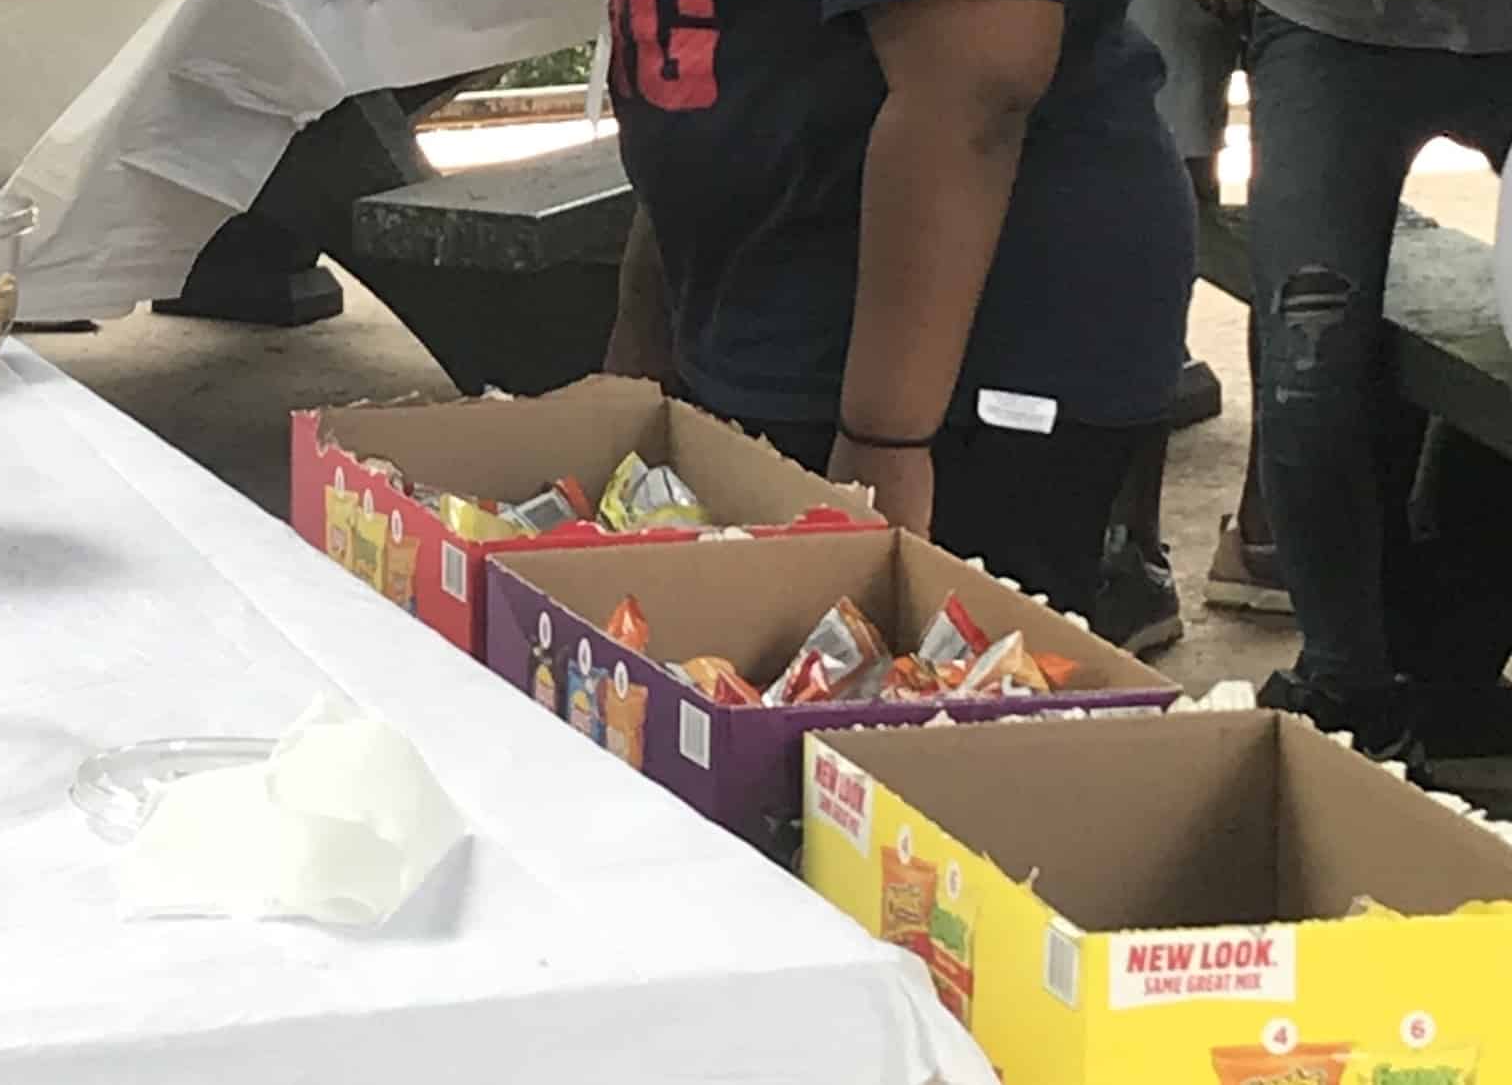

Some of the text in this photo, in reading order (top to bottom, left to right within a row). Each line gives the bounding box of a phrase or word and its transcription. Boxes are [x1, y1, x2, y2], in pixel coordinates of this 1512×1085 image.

[1125, 942, 1194, 973] NEW
[1143, 972, 1262, 996] SAME GREAT MIX
[1272, 1026, 1288, 1046] 4
[1409, 1018, 1426, 1040] 6
